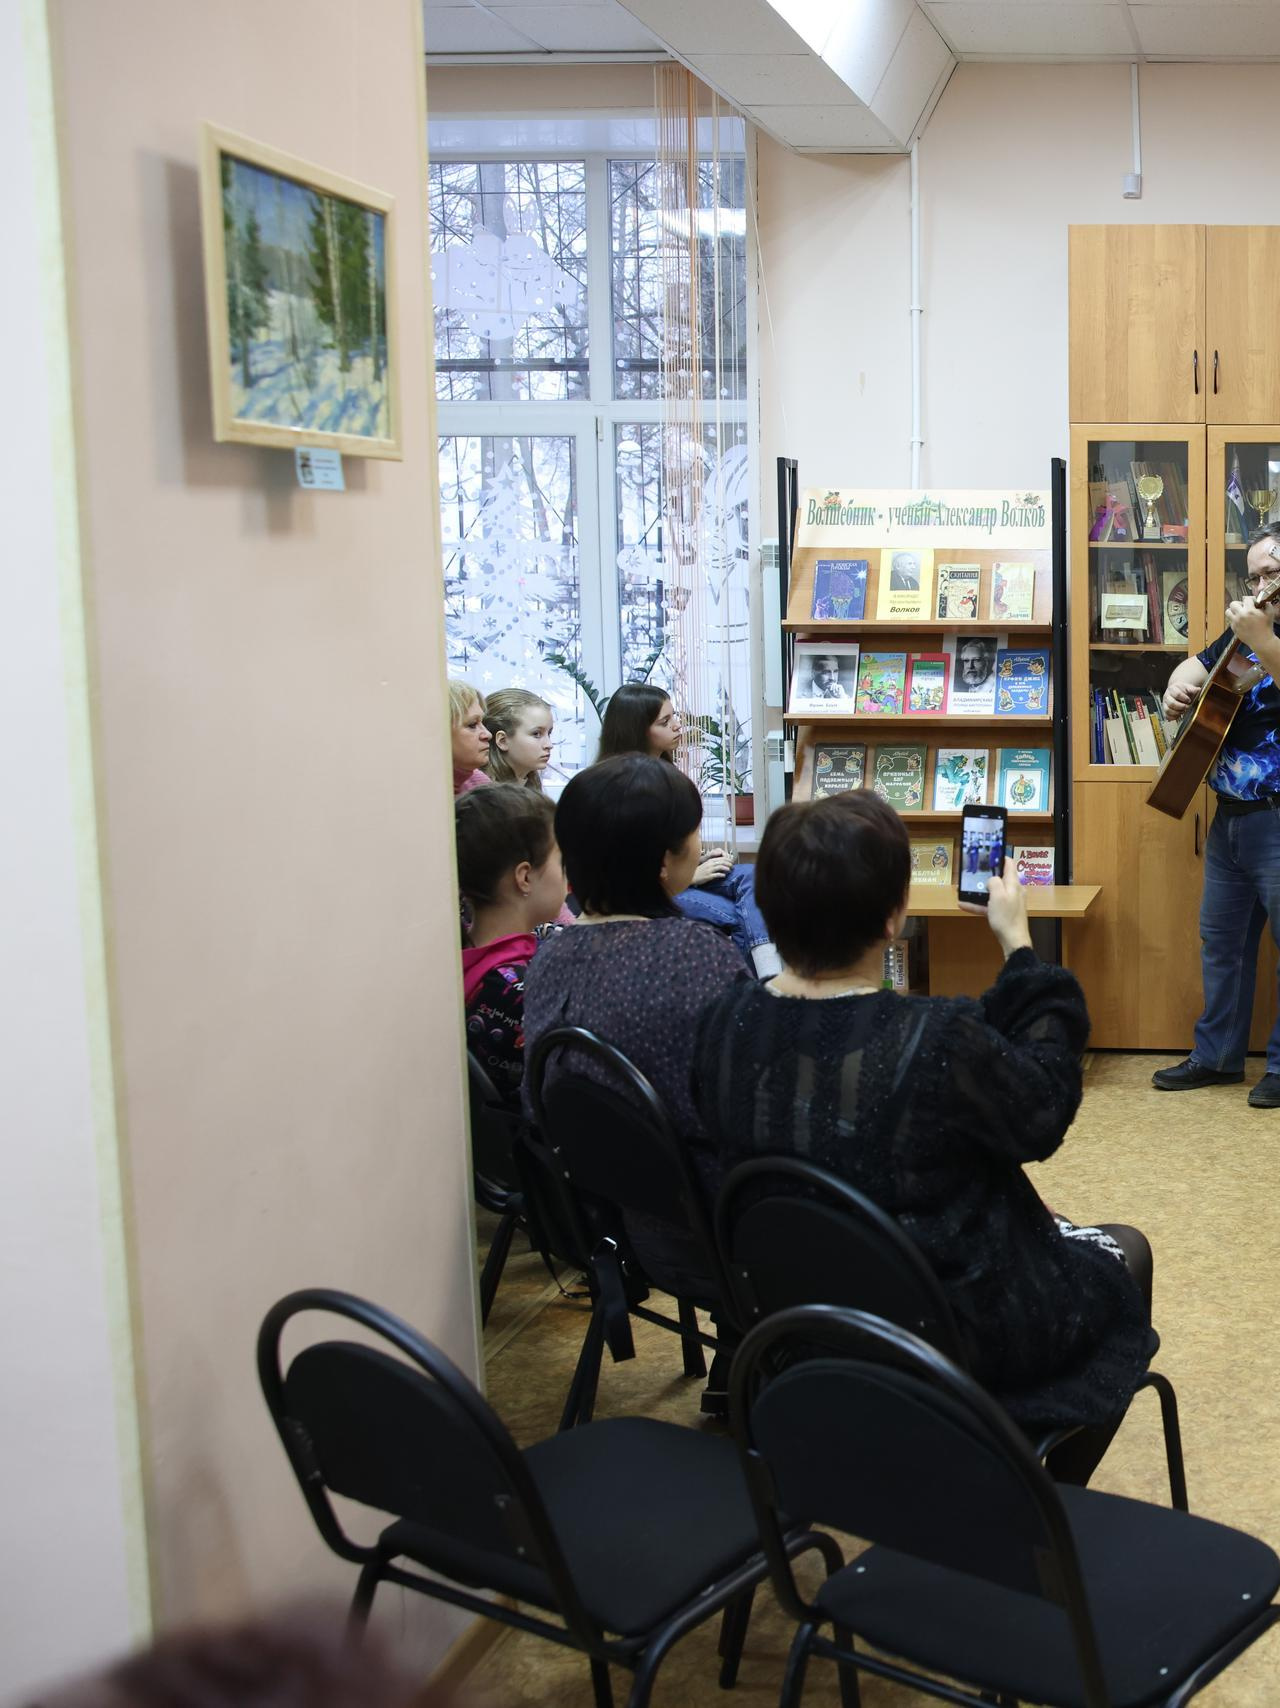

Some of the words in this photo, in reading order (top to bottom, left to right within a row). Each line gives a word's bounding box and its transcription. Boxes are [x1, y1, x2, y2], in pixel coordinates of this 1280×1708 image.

[807, 498, 877, 526] Волшебник
[886, 504, 931, 533] ученый
[933, 504, 997, 534] Александр
[1000, 499, 1046, 528] Волков
[889, 606, 921, 614] Волков
